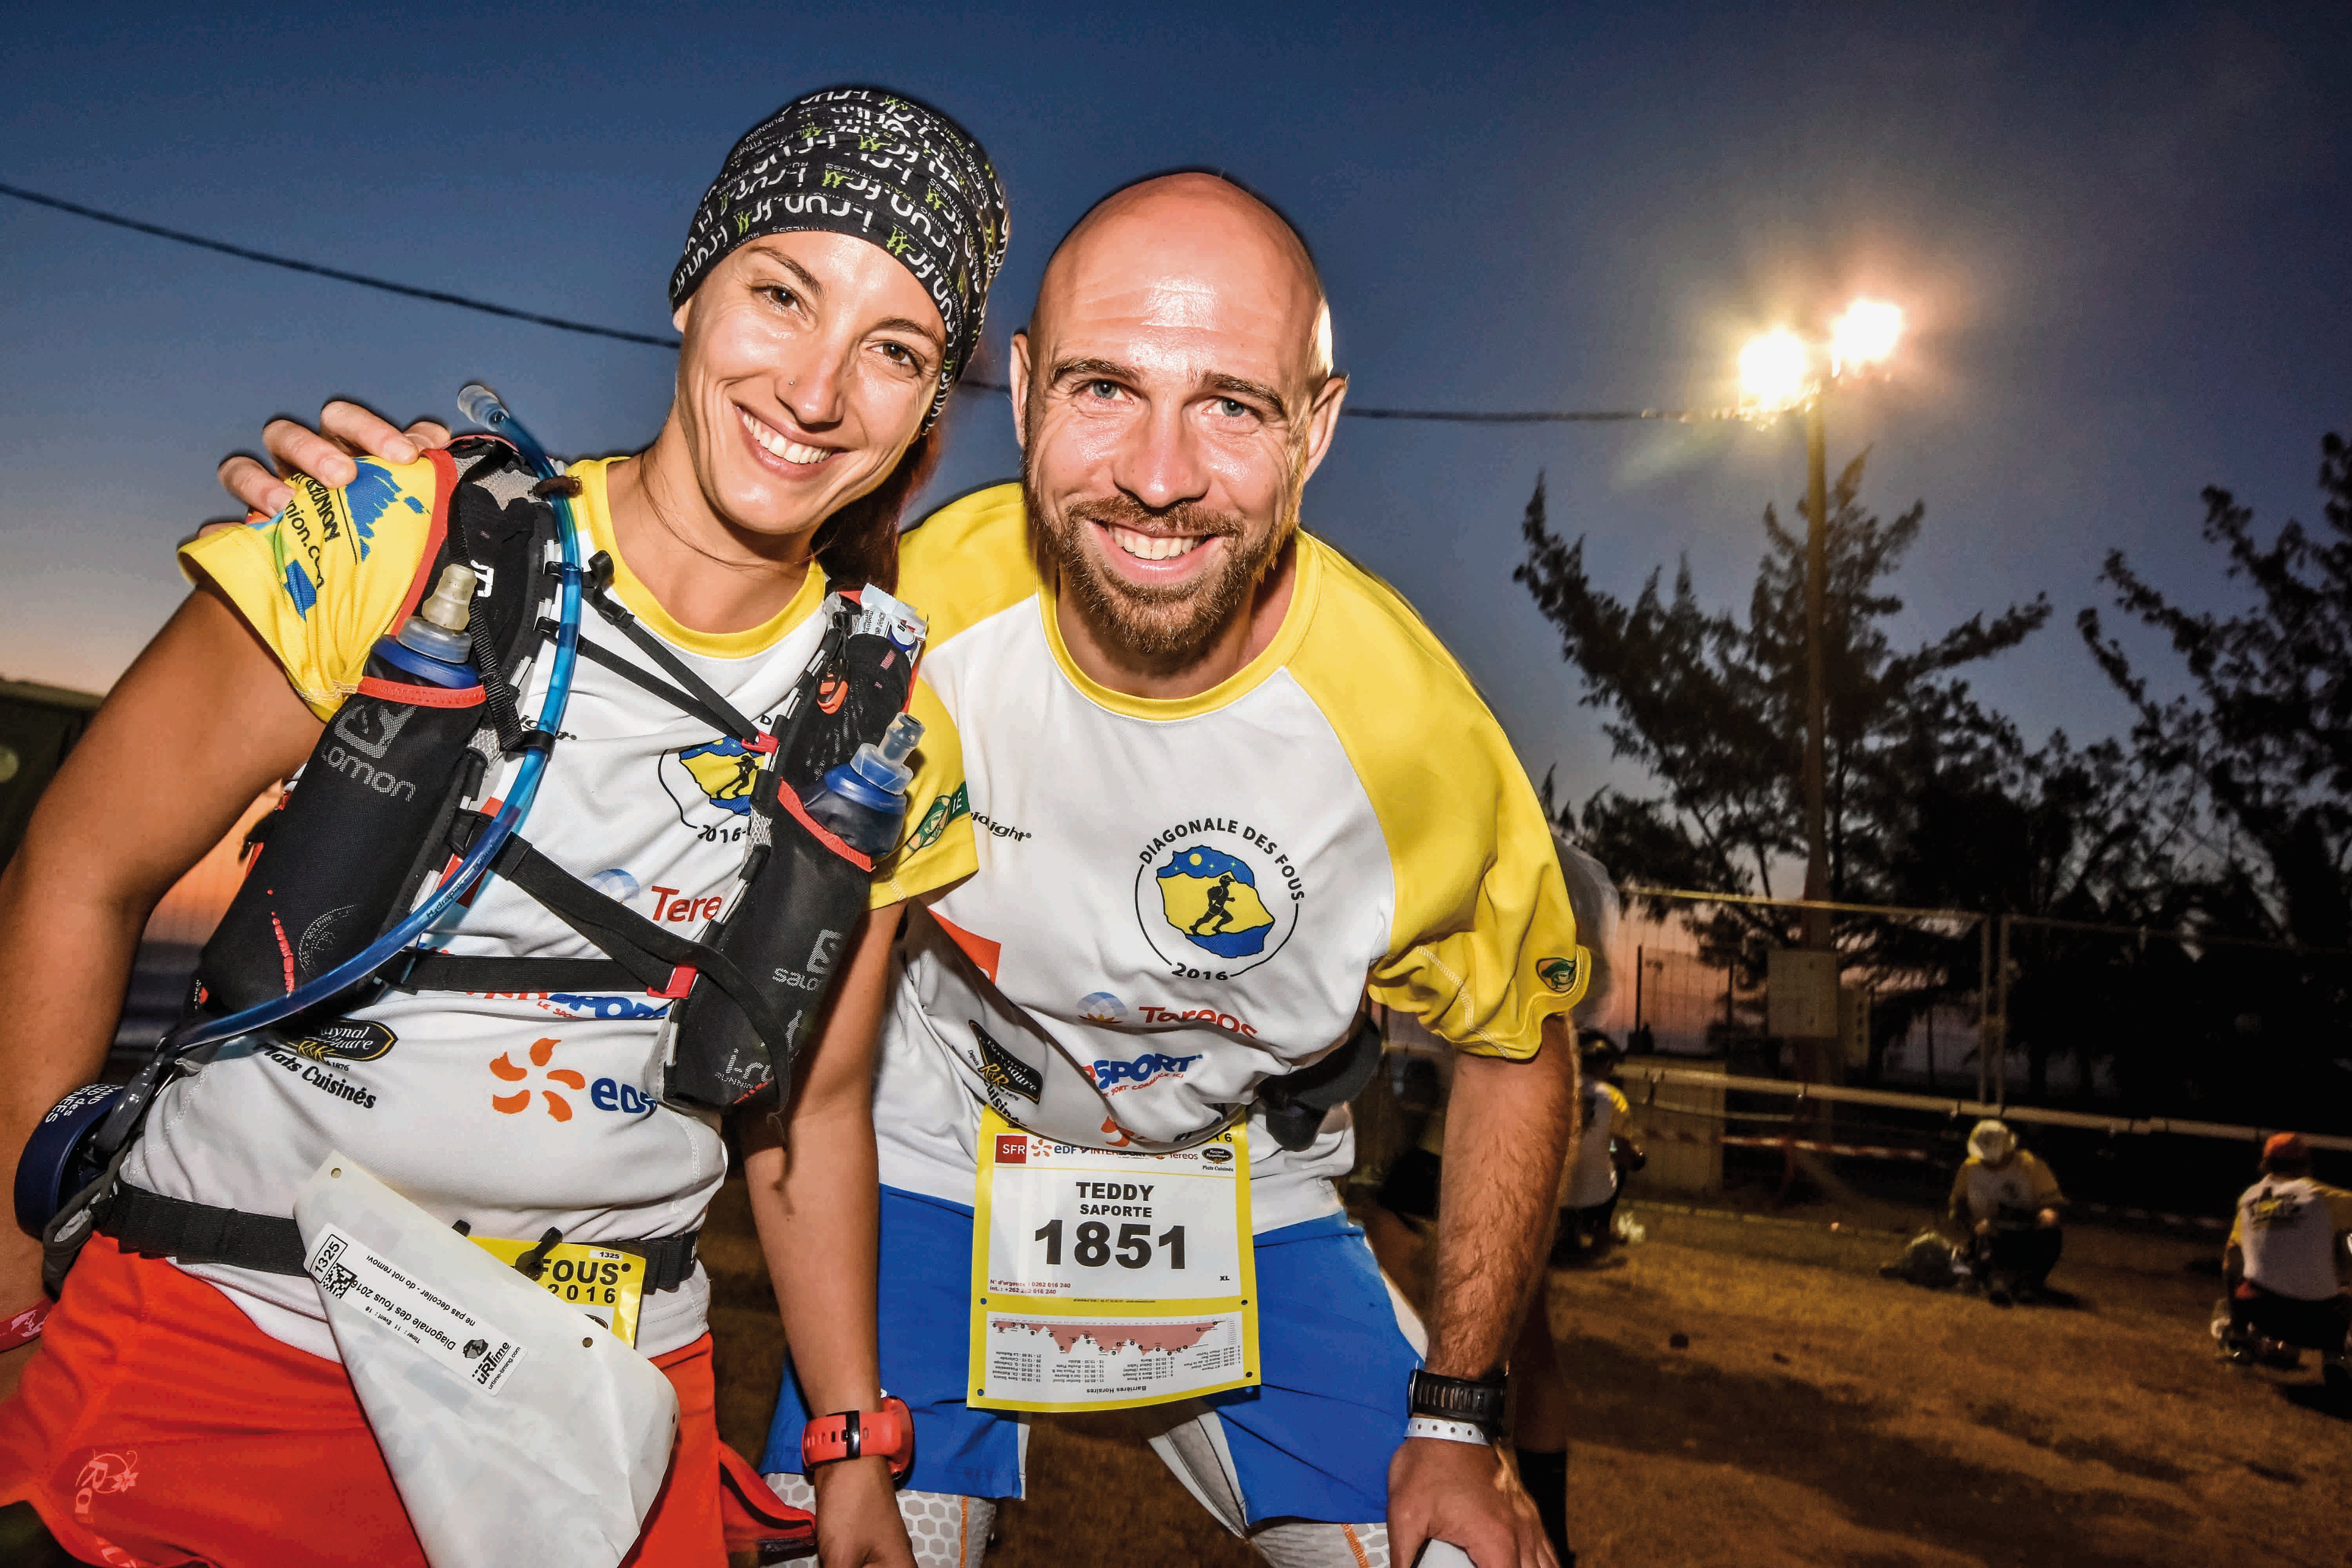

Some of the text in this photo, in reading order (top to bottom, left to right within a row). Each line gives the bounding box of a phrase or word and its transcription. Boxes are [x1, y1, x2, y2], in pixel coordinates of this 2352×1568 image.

[826, 163, 880, 183] FITNESS
[929, 178, 964, 220] FITNESS
[752, 195, 873, 232] i-run.fr
[1139, 817, 1305, 901] DIAGONALE DES FOUS
[1171, 962, 1229, 981] 2016
[301, 1066, 377, 1109] Cuisinés
[63, 1098, 85, 1116] des
[1002, 1143, 1026, 1155] SFR
[1054, 1145, 1078, 1154] eDF
[1076, 1181, 1154, 1202] TEDDY
[1079, 1203, 1152, 1218] SAPORTE
[1034, 1218, 1186, 1270] 1851
[315, 1241, 340, 1274] 1325
[599, 1251, 620, 1259] 1325
[392, 1271, 406, 1283] not
[406, 1279, 416, 1290] do
[420, 1289, 451, 1311] decoller
[350, 1280, 457, 1351] Diagonale des fous 2016
[450, 1308, 466, 1320] pas
[465, 1316, 477, 1327] ne
